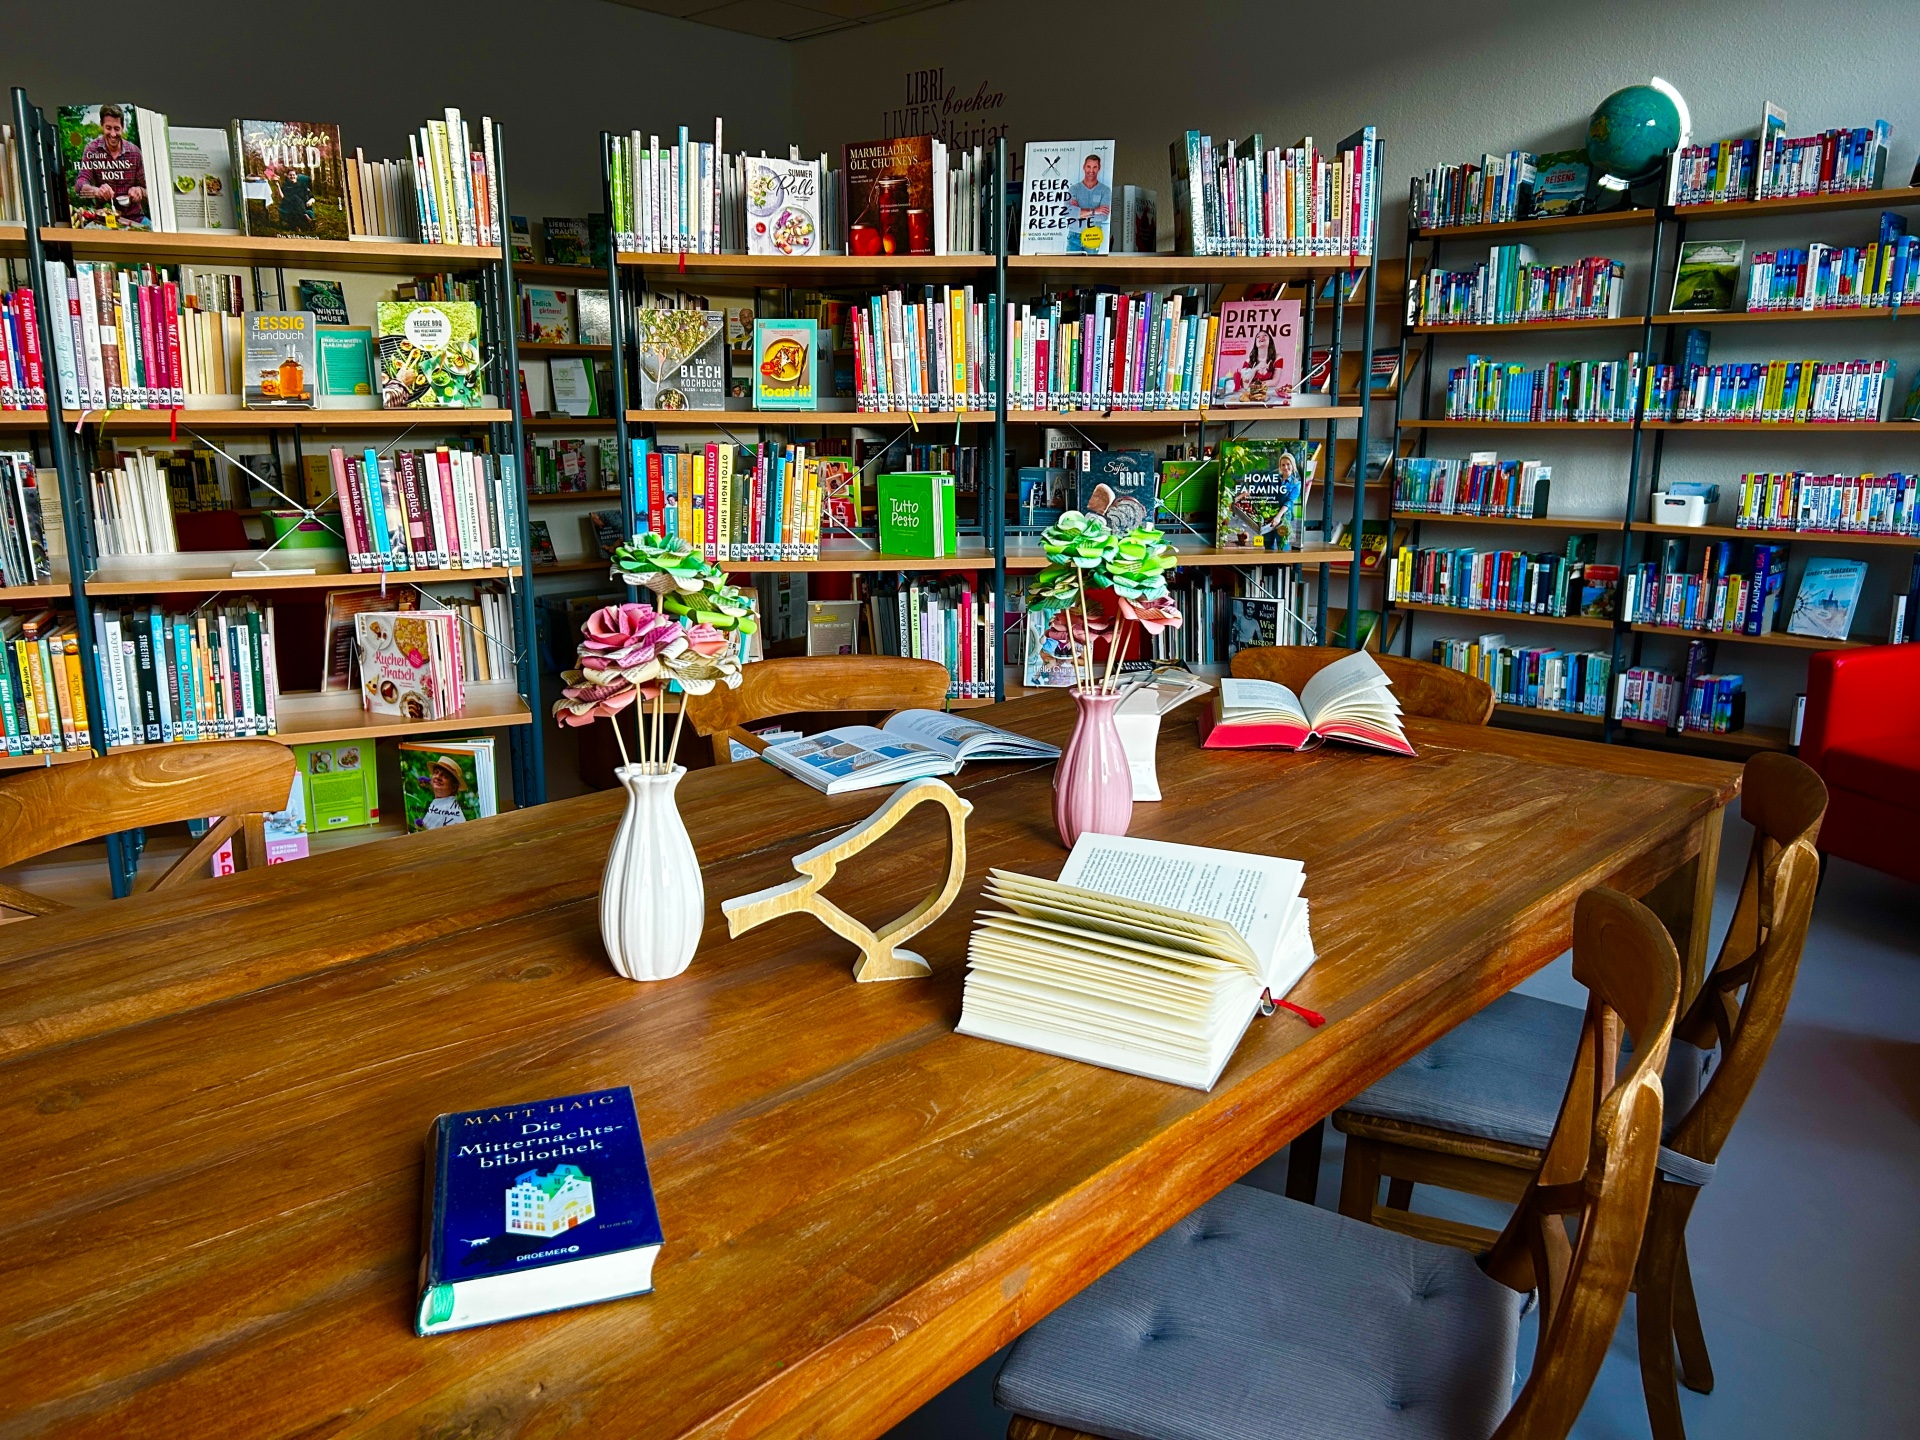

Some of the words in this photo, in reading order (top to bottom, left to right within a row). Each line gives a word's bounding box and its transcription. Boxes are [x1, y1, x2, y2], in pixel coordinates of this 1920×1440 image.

[906, 68, 944, 105] LIBRI
[942, 80, 1007, 116] boeken
[884, 104, 939, 140] LIVRES
[73, 159, 133, 170] HAUSMANNS-
[261, 146, 321, 168] WILD
[851, 159, 869, 170] ÖLE,
[1719, 149, 1727, 173] Baltikum
[102, 171, 125, 180] KOST
[788, 169, 813, 178] SUMMER
[1545, 173, 1575, 184] REISENS
[767, 173, 816, 196] Rolls
[1032, 179, 1072, 190] FEIER-
[1030, 192, 1076, 202] ABEND-
[1029, 205, 1072, 217] BLITZ-
[1029, 217, 1096, 229] REZEPTE
[24, 308, 32, 320] VON
[70, 300, 78, 314] TOPP
[1226, 308, 1281, 323] DIRTY
[252, 316, 260, 331] Das
[260, 316, 305, 330] ESSIG
[1225, 323, 1291, 338] EATING
[27, 322, 36, 354] EINMACHEN
[168, 324, 178, 347] MEZE
[252, 331, 304, 340] Handbuch
[1149, 321, 1158, 377] WALDKOCHBUCH
[30, 362, 40, 382] OETKER
[172, 351, 180, 387] VEGETARISCH
[681, 365, 721, 379] BLECH
[681, 379, 722, 388] KOCHBUCH
[759, 385, 795, 397] Toast
[798, 386, 813, 396] it!
[1767, 370, 1776, 396] Norwegen
[1800, 369, 1810, 398] Oberitalien
[1830, 376, 1842, 406] Provence
[1870, 374, 1880, 398] Schweiz
[369, 464, 378, 488] GENIAL
[650, 458, 658, 478] JAMIES
[1104, 461, 1129, 475] Süßes
[403, 458, 420, 518] Küchenglück
[1120, 472, 1146, 486] BROT
[1244, 474, 1279, 483] HOME
[348, 463, 362, 516] Heimwehküche
[468, 492, 476, 506] ZERO
[506, 488, 514, 510] Hussain
[650, 479, 660, 505] AMERIKA
[1235, 485, 1287, 494] FARMING
[341, 496, 352, 529] Hähnchen
[373, 491, 382, 516] VEGAN
[890, 498, 919, 513] Tutto
[1841, 488, 1850, 518] Teneriffa
[652, 510, 660, 526] JAMIE
[707, 506, 715, 540] FLAVOUR
[720, 510, 728, 538] SIMPLE
[891, 512, 920, 527] Pesto
[1755, 552, 1765, 569] USA
[1751, 570, 1763, 613] TRAUMZIEL
[1738, 592, 1746, 611] Westen
[899, 599, 907, 627] RAMSAY
[1259, 610, 1274, 619] Kugel
[1260, 620, 1274, 629] Wie
[1263, 630, 1274, 638] ich
[110, 631, 124, 691] KARTOFFELGLÜCK
[138, 634, 150, 670] STREETFOOD
[374, 651, 408, 667] Kuchen
[30, 652, 42, 692] LANDKÜCHE
[168, 664, 178, 694] VEGANISTA
[232, 671, 240, 688] ALEX
[381, 665, 415, 681] Tratsch
[0, 679, 9, 701] FUTURE
[72, 674, 84, 722] WinterKüche
[3, 702, 12, 714] FOR
[36, 693, 45, 712] UNSERE
[234, 690, 242, 711] KOCHT
[5, 715, 16, 735] VEGGIE
[732, 747, 758, 760] Ges
[464, 1109, 535, 1126] MATT
[549, 1096, 614, 1113] HAIG
[521, 1122, 562, 1134] Die
[458, 1125, 623, 1156] Mitternachts-
[480, 1140, 603, 1168] bibliothek
[599, 1219, 633, 1229] Roman
[516, 1248, 568, 1262] DROEMER
